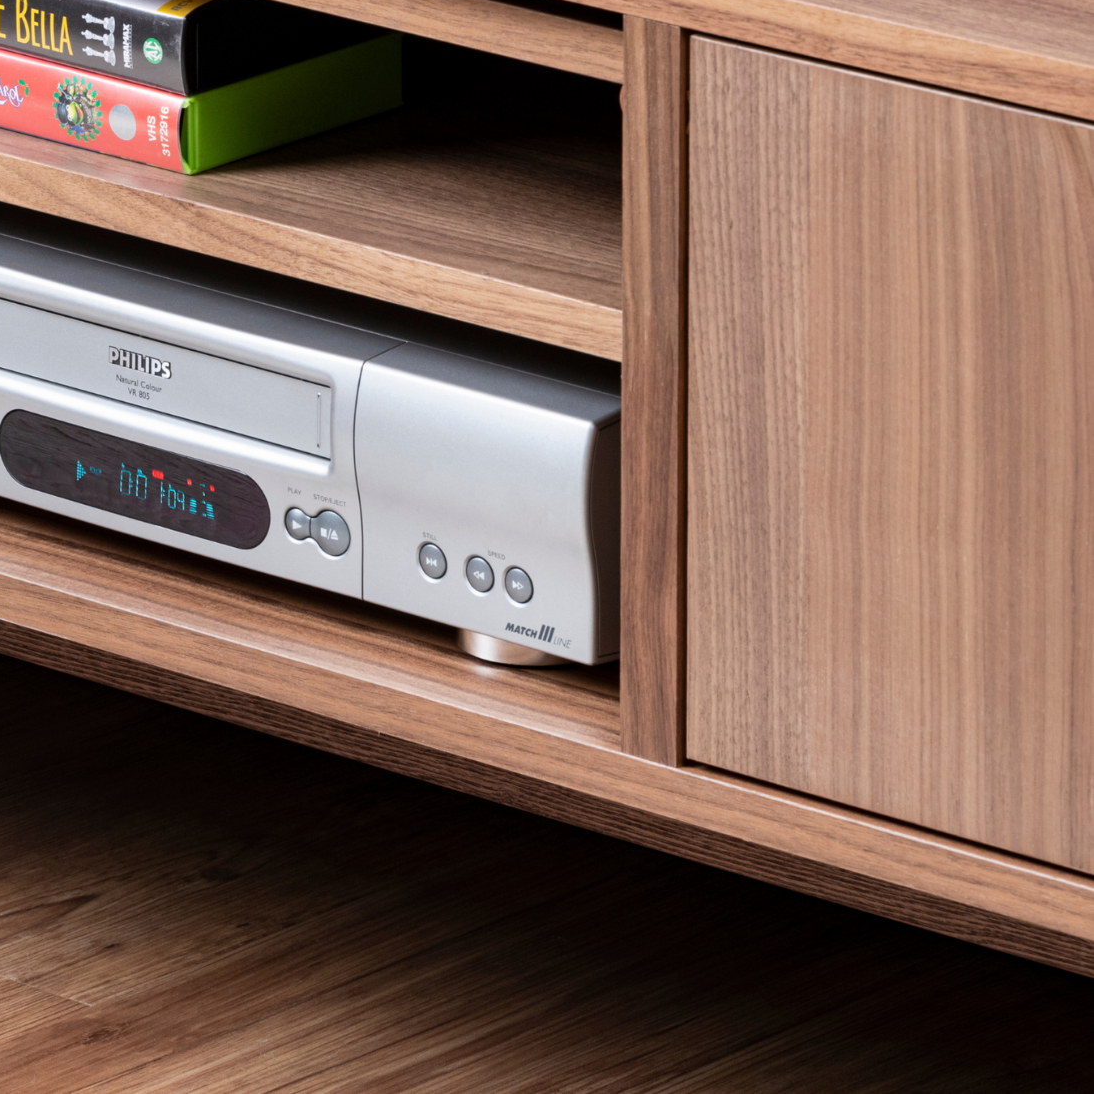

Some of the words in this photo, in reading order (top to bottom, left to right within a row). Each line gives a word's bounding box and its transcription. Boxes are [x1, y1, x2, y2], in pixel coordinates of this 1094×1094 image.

[122, 23, 130, 68] MIRAMAX
[147, 115, 157, 142] VHS
[159, 106, 171, 157] 3172916
[108, 345, 172, 379] PHILIPS
[116, 374, 139, 387] Natural
[140, 380, 162, 393] Colour
[128, 387, 137, 397] VR
[138, 390, 150, 400] 805
[287, 486, 302, 496] PLAY
[312, 493, 347, 508] STOP/EJECT
[422, 531, 438, 542] STILL
[487, 550, 506, 561] SPEED
[505, 622, 538, 639] MATCH
